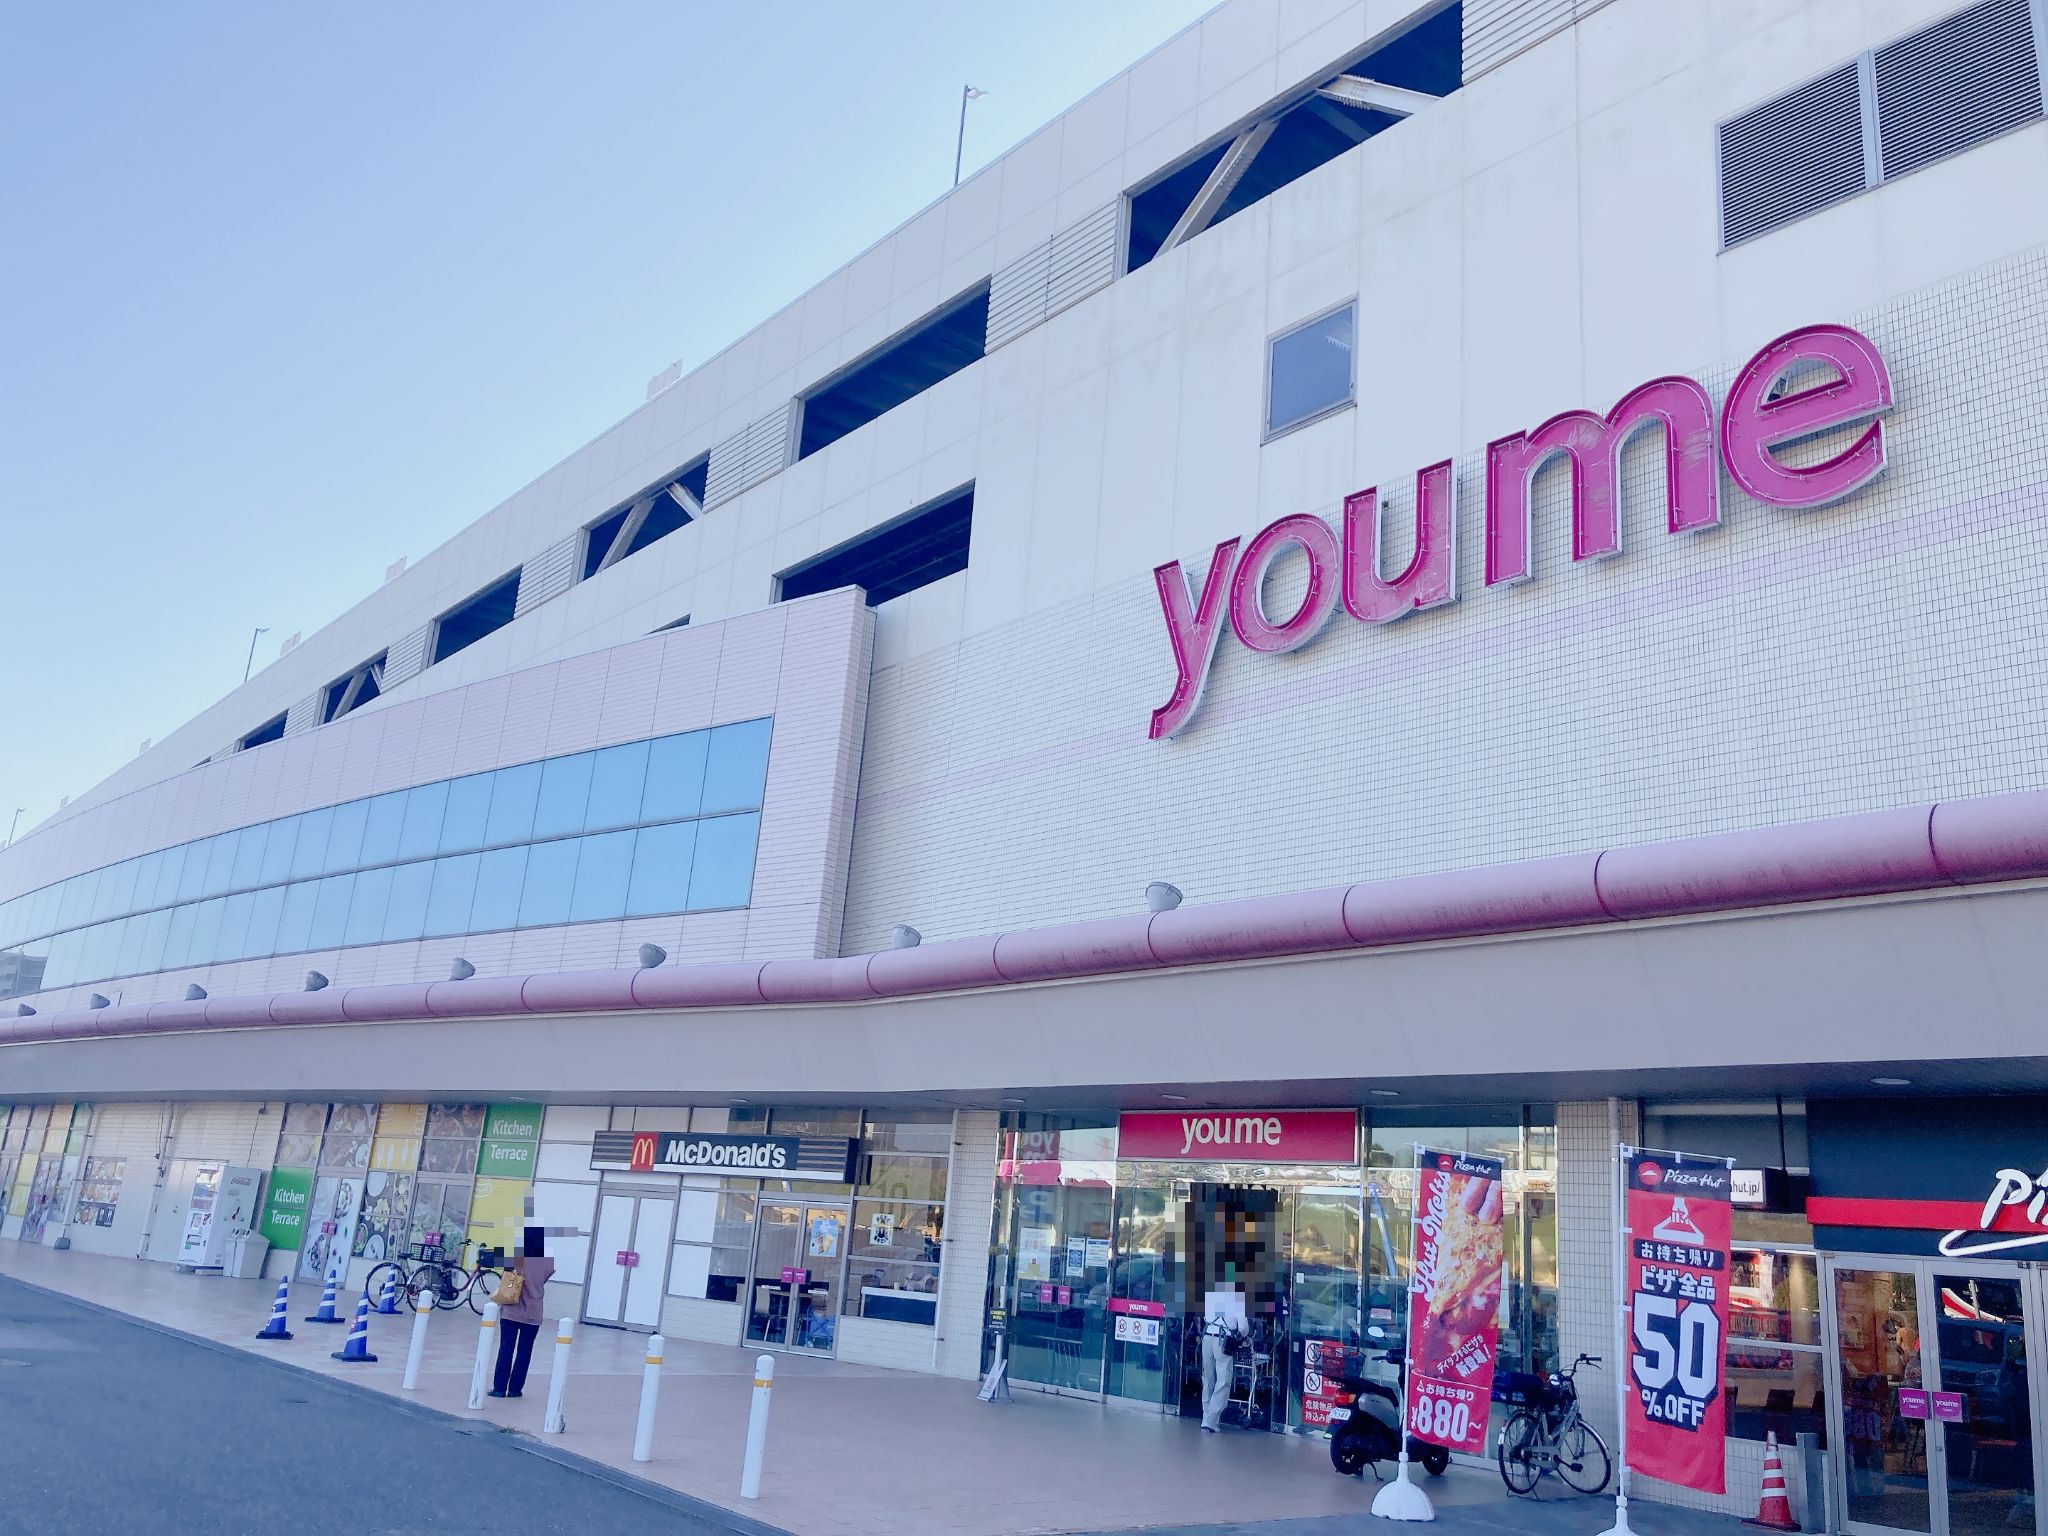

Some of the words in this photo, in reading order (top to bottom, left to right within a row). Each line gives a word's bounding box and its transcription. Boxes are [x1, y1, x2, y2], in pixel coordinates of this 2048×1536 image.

[492, 1120, 532, 1136] Kitchen
[490, 1144, 528, 1160] Terrace
[665, 1139, 786, 1168] McDonald's
[1454, 1159, 1475, 1171] Pizza
[1475, 1164, 1492, 1174] Hut
[1664, 1169, 1698, 1184] Pizza
[1696, 1173, 1726, 1188] Hut
[274, 1188, 304, 1204] Kitchen
[1731, 1180, 1760, 1196] hut.jp/
[1980, 1167, 2048, 1229] Pi
[271, 1209, 300, 1226] Terrace
[1641, 1242, 1715, 1268] お持ち帰り
[1641, 1265, 1717, 1301] ピザ全品
[1632, 1291, 1720, 1399] 50
[1426, 1383, 1474, 1401] お持ち帰り
[1305, 1400, 1334, 1412] 危険物品
